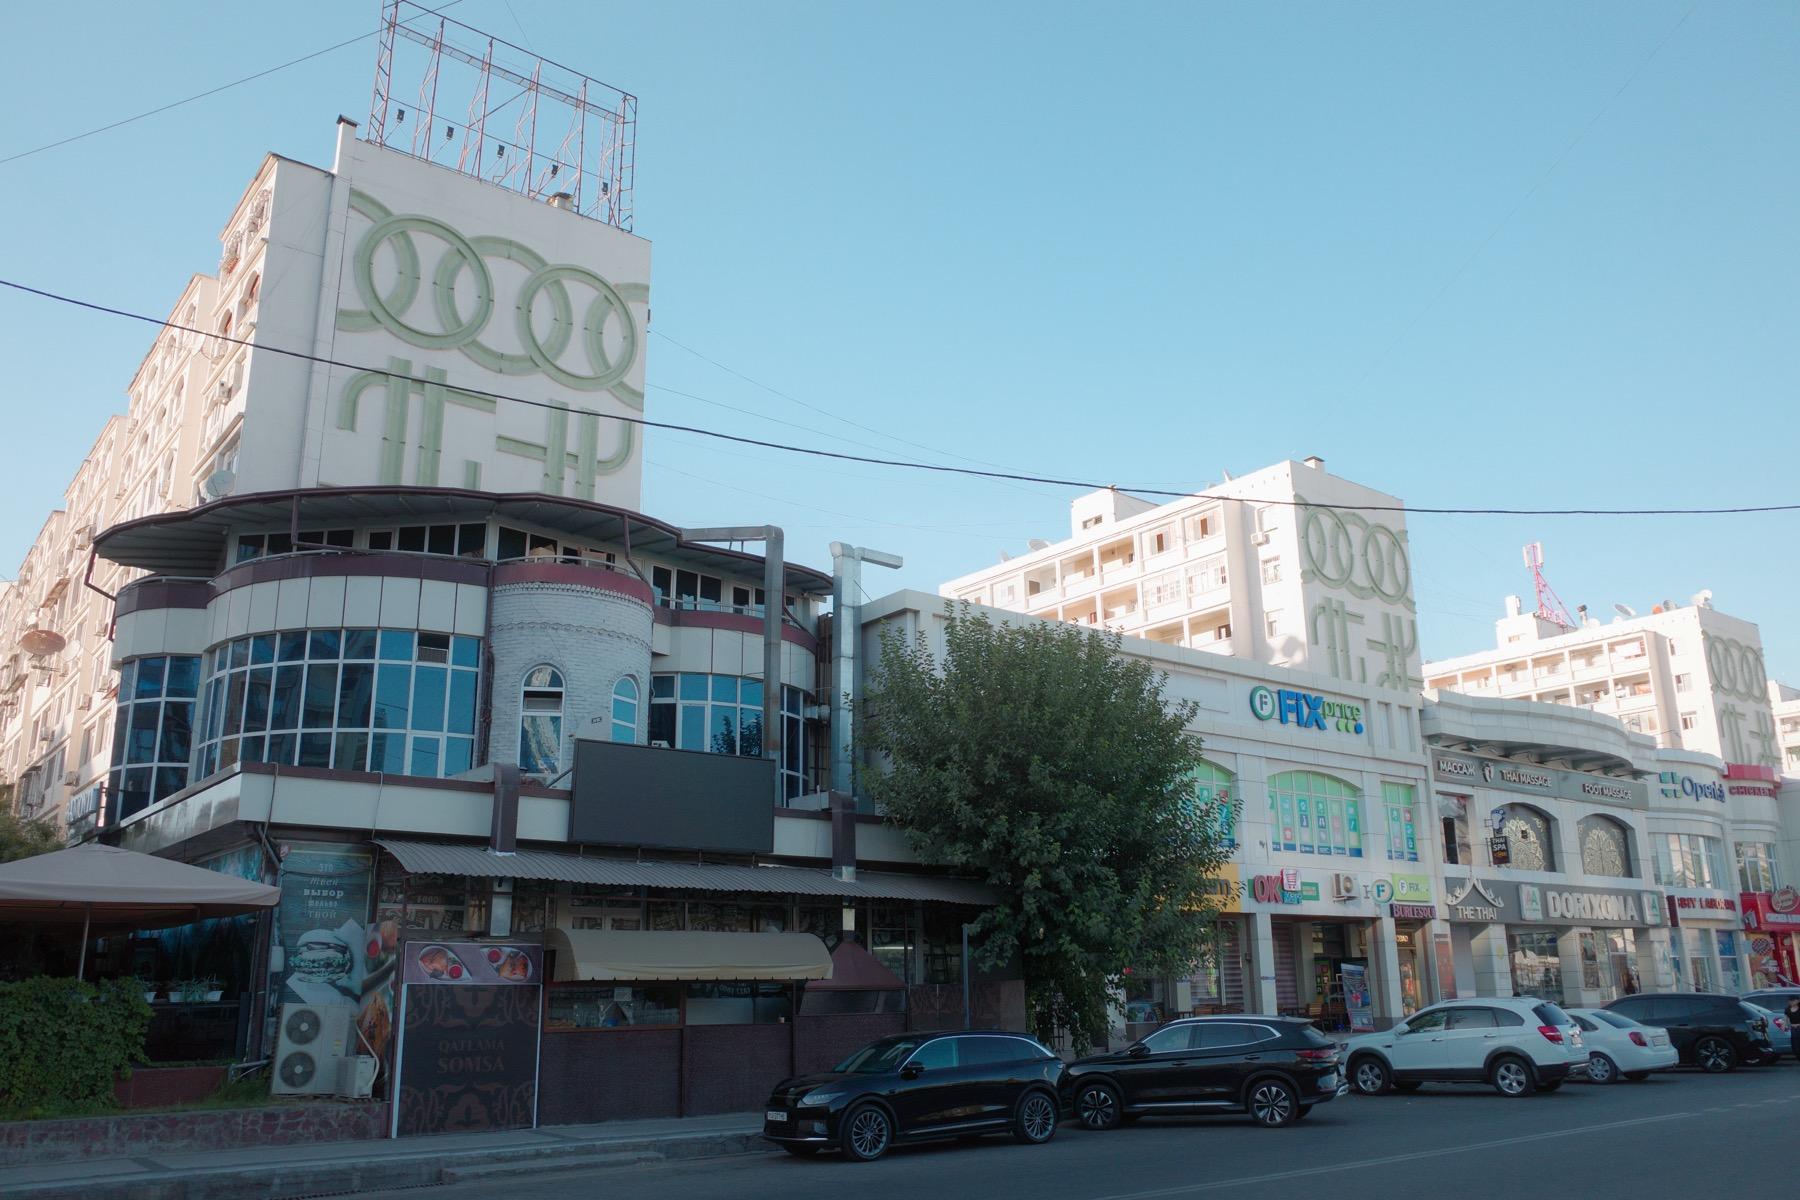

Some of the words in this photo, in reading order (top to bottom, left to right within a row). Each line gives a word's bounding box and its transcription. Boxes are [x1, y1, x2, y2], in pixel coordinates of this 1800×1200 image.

[1438, 760, 1477, 776] МАССАЖ
[1501, 769, 1520, 782] THAI
[1519, 772, 1553, 788] MASSAGE
[1583, 783, 1603, 795] FOOT
[1602, 786, 1633, 800] MASSAGE
[1493, 843, 1507, 851] SPA
[1254, 874, 1283, 904] OK
[1456, 905, 1476, 919] THE
[1477, 906, 1497, 920] THAI
[1545, 890, 1639, 921] DORIXONA
[436, 1055, 505, 1073] SOMSA
